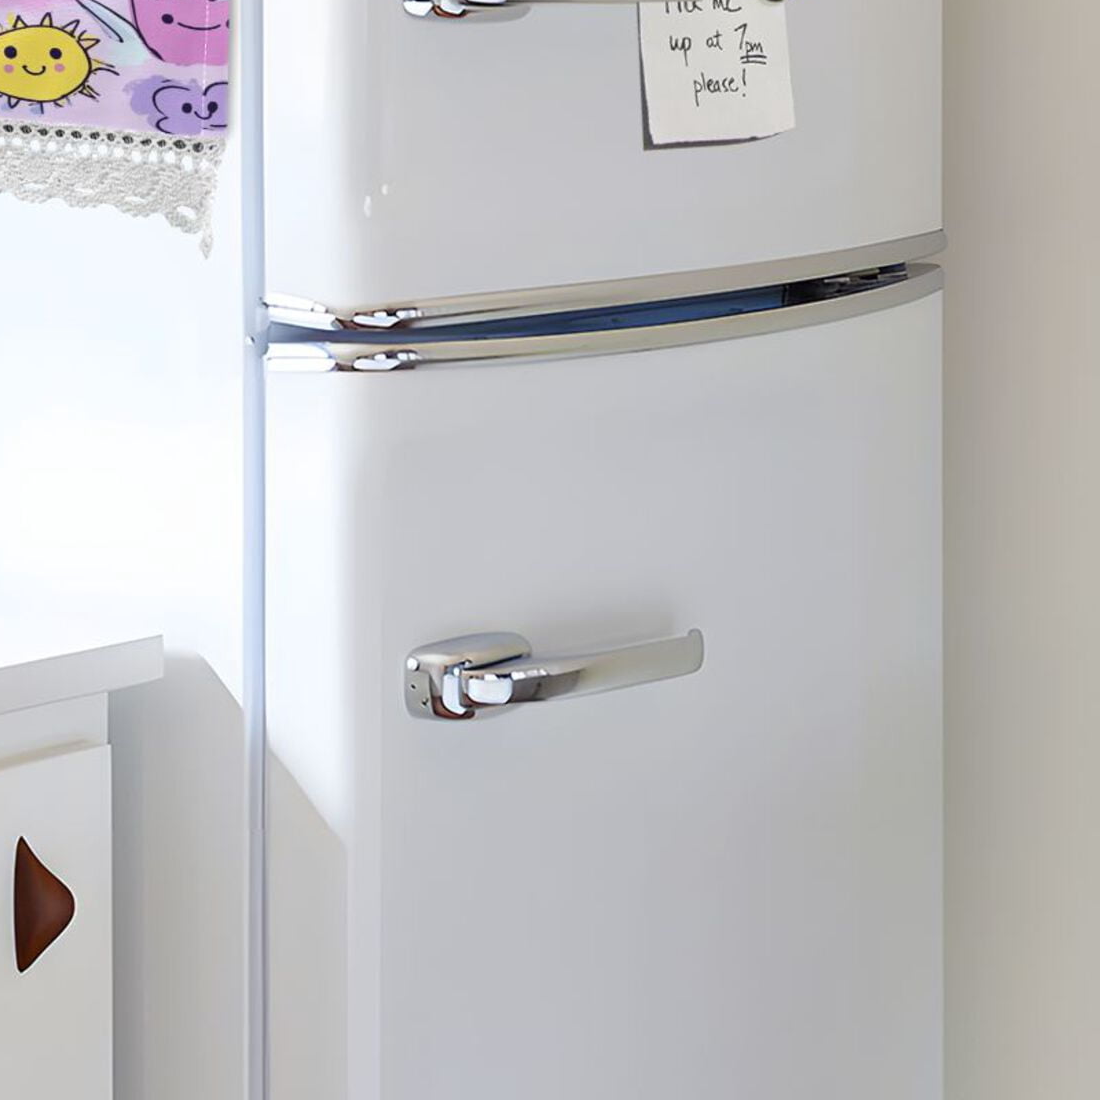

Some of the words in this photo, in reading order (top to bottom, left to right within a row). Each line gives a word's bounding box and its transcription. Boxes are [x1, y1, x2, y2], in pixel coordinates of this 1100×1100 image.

[669, 34, 692, 67] up
[705, 29, 723, 51] at
[693, 68, 746, 108] please!
